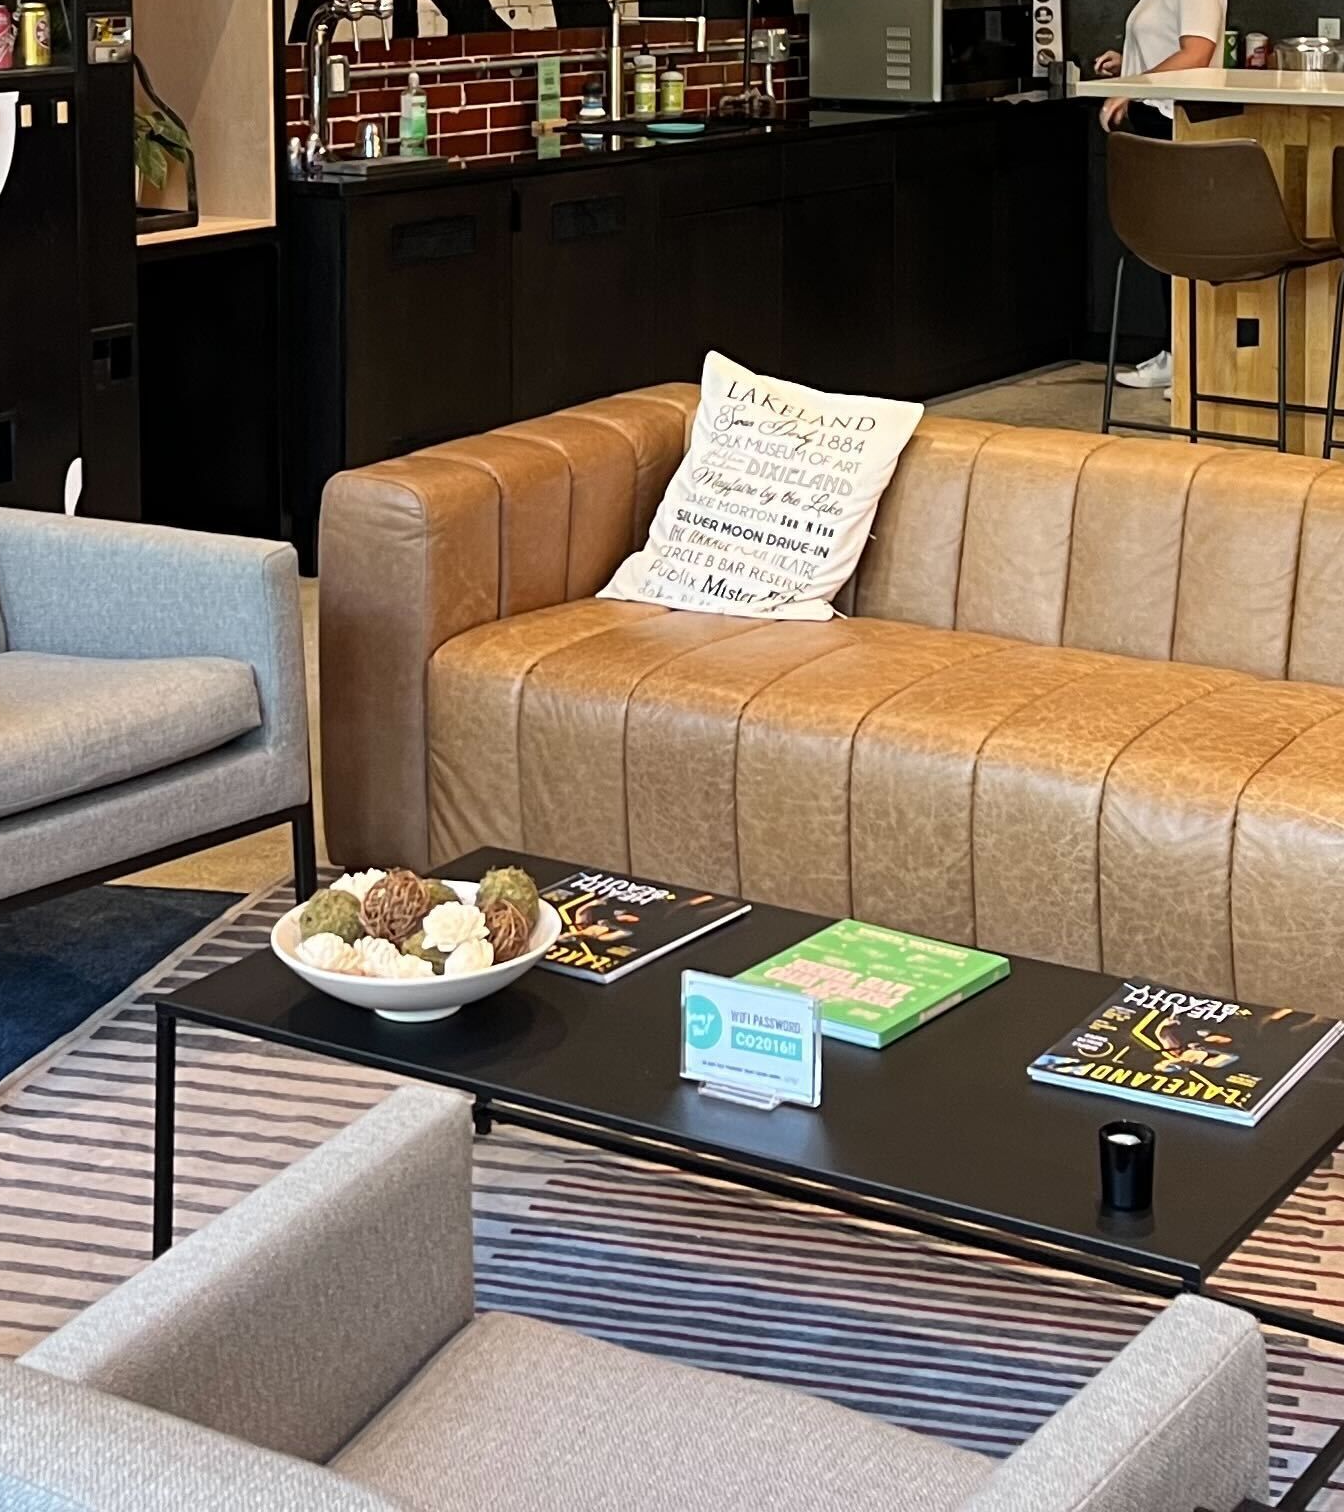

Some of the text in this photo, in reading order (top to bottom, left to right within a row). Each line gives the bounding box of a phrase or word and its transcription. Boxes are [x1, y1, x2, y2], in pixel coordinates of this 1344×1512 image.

[727, 381, 877, 432] LAKELAND
[710, 432, 742, 449] POLK
[744, 438, 807, 463] MUSEUM
[808, 451, 833, 466] OF
[832, 459, 863, 475] ART
[816, 432, 866, 455] 1884
[745, 458, 854, 497] DIXIELAND
[716, 500, 779, 524] MORTON
[759, 486, 778, 506] by
[781, 491, 801, 506] the
[801, 493, 844, 518] Lake
[676, 508, 719, 532] SILVER
[720, 522, 765, 544] MOON
[765, 534, 830, 559] DRIVE-IN
[648, 559, 697, 588] Publix
[700, 574, 757, 604] Mister
[659, 544, 812, 593] CIRCLE B BAR RESERVE
[753, 1014, 802, 1034] PASSWORD
